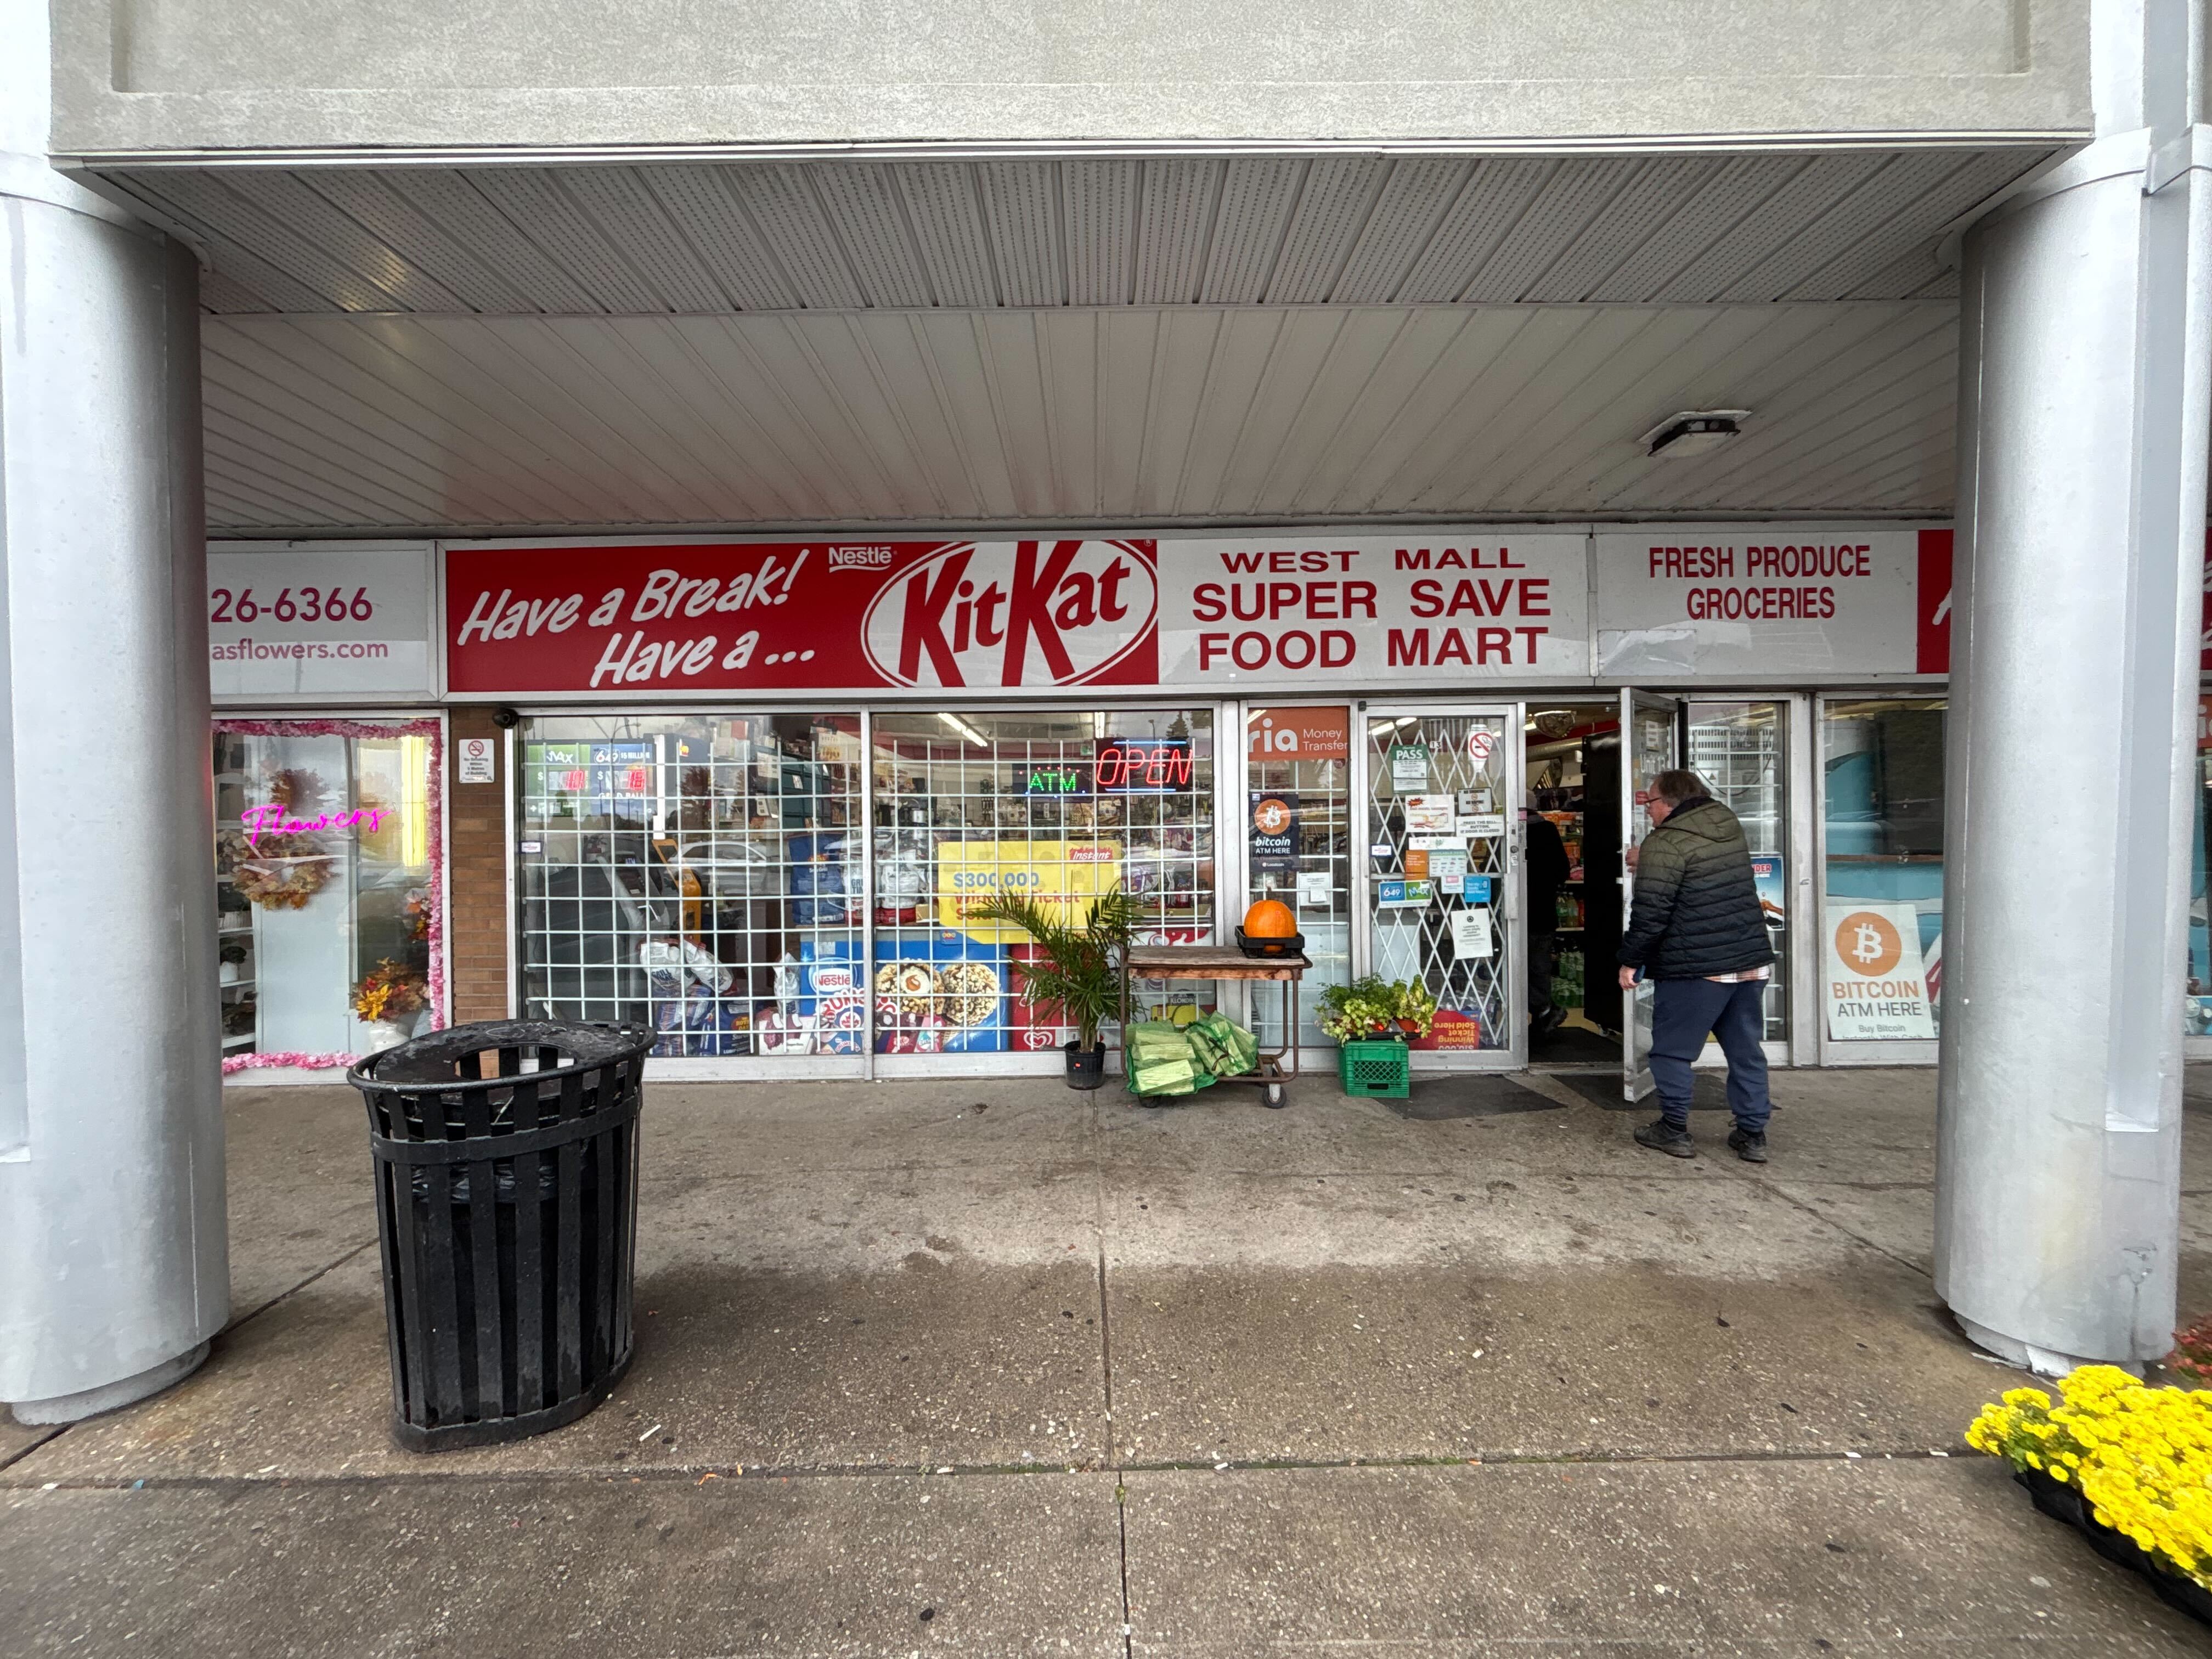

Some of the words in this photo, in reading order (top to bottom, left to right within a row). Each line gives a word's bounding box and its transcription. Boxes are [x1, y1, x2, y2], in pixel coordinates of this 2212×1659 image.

[829, 546, 891, 565] Nestlé
[1220, 551, 1359, 573] WEST
[1395, 548, 1526, 569] MALL
[1649, 546, 1734, 578] FRESH
[1747, 545, 1871, 577] PRODUCE
[211, 587, 373, 623] 26-6366
[458, 589, 583, 646] Have
[589, 588, 625, 627] a
[631, 549, 810, 623] Break!
[1192, 580, 1378, 622] SUPER
[1410, 579, 1551, 618] SAVE
[1686, 586, 1835, 620] GROCERIES
[212, 638, 388, 660] asflowers.com
[589, 631, 718, 689] Have
[723, 630, 759, 670] a
[1199, 629, 1357, 670] FOOD
[1387, 627, 1549, 667] MART
[1248, 718, 1298, 753] ria
[1302, 740, 1348, 751] Transfer
[1303, 729, 1342, 740] Money
[1396, 749, 1423, 760] PASS
[1097, 748, 1194, 785] OPEN
[1029, 772, 1076, 791] ATM
[241, 805, 393, 845] Flowers
[1255, 836, 1291, 847] bitcoin
[953, 871, 1040, 889] $300,000
[1832, 980, 1920, 999] BITCOIN
[1838, 1002, 1874, 1017] ATM
[1877, 1002, 1923, 1017] HERE
[1438, 1035, 1475, 1043] Winning
[1858, 1024, 1875, 1034] Buy
[1876, 1024, 1906, 1032] Bitcoin
